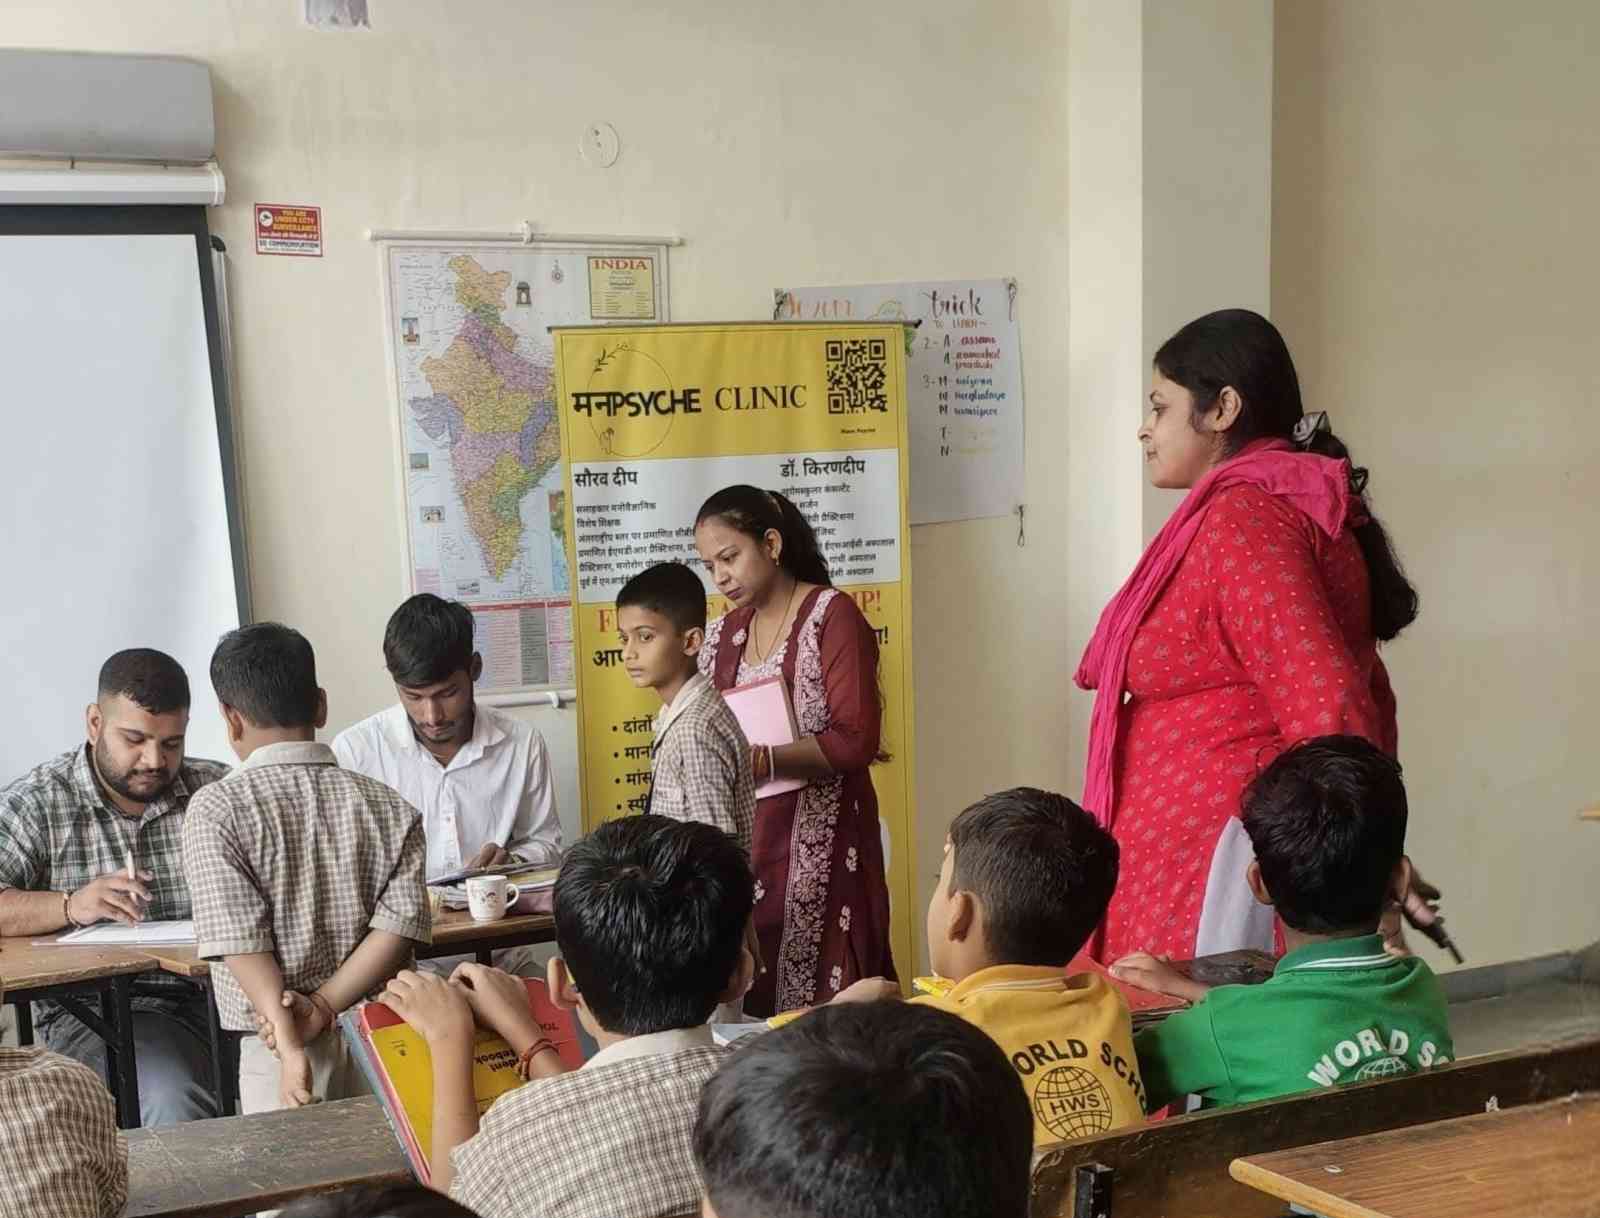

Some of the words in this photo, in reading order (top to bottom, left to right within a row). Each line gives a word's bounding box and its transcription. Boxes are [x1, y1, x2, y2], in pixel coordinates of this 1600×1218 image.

[592, 259, 648, 270] INDIA
[930, 288, 984, 319] trick
[714, 384, 808, 412] CLINIC
[574, 467, 609, 487] सौरव
[612, 466, 638, 486] दीप
[780, 457, 799, 477] डॉ.
[803, 455, 866, 477] किरणदीप
[1011, 1038, 1089, 1076] ORLD
[1307, 1028, 1409, 1087] WORD
[1050, 1092, 1101, 1116] HWS
